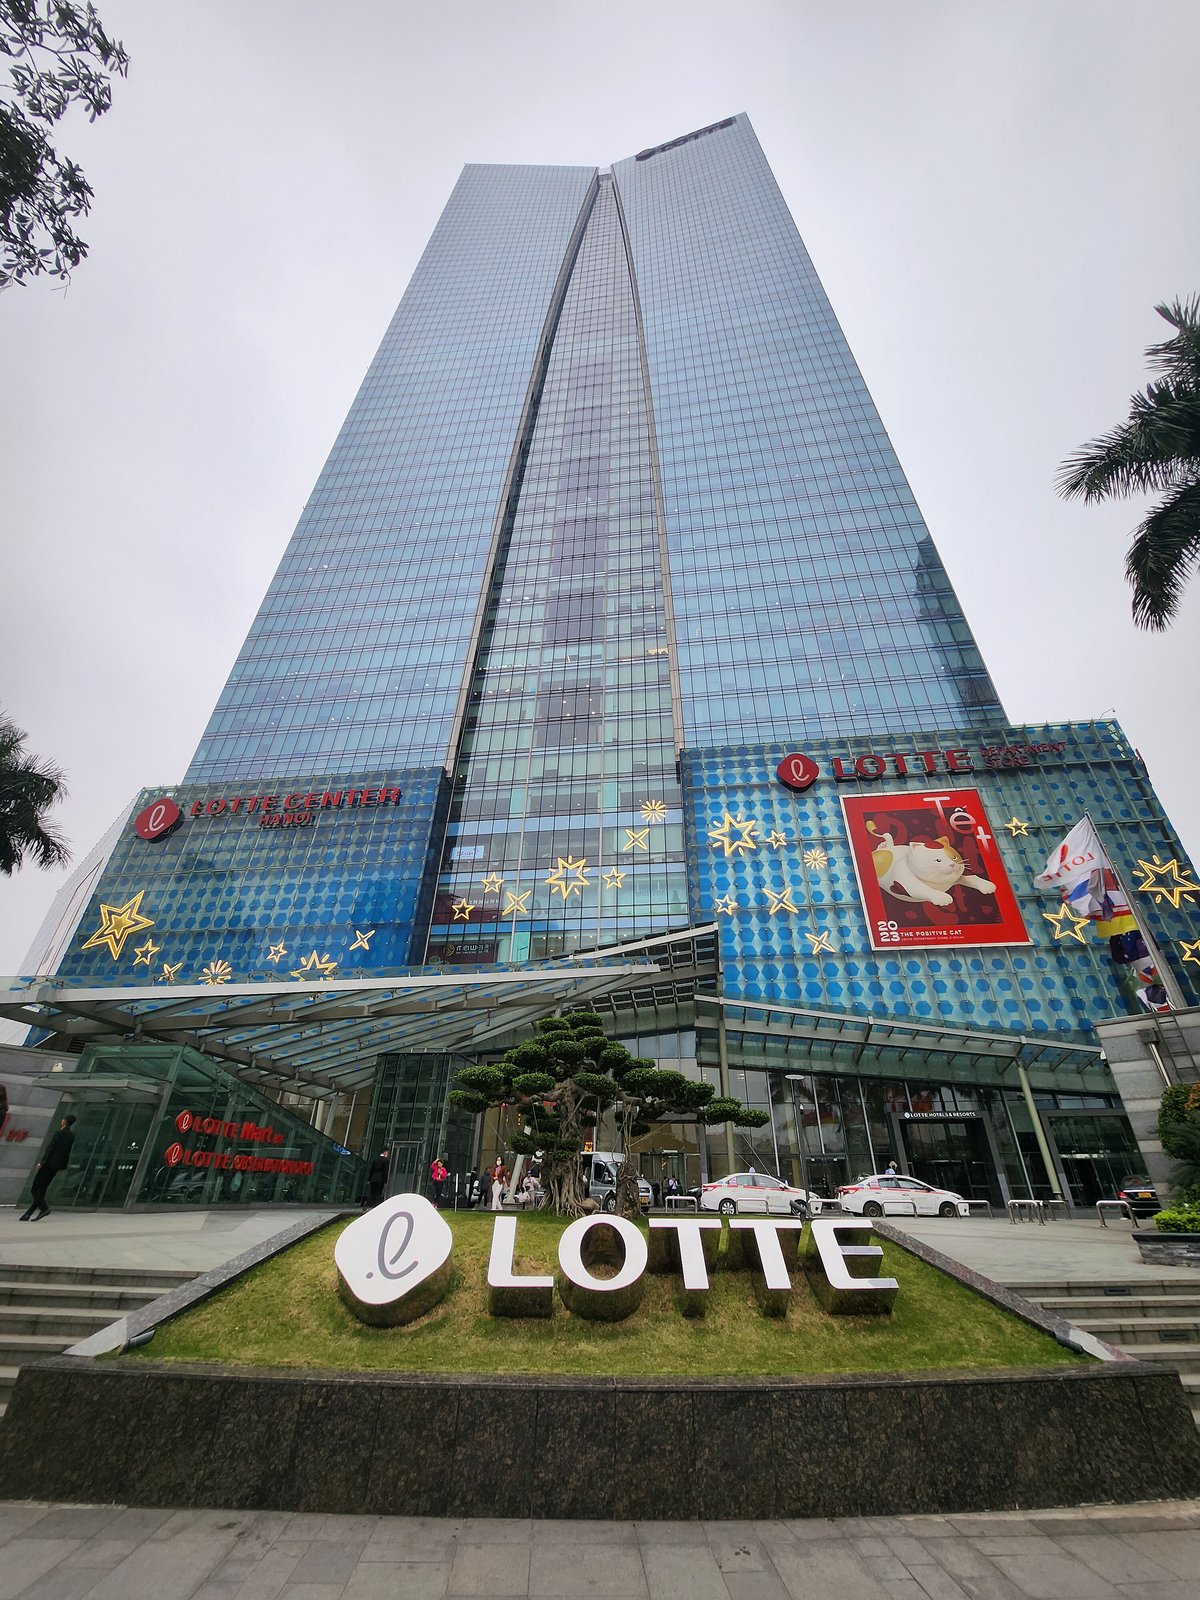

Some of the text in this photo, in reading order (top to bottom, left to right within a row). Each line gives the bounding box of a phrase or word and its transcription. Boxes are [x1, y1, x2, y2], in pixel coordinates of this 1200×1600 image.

[832, 749, 975, 779] LOTTE
[190, 787, 401, 817] LOTTE CENTER
[258, 812, 312, 828] HANOI
[193, 1116, 240, 1138] LOTTE
[240, 1121, 274, 1143] Mart
[182, 1149, 232, 1169] LOTTE
[487, 1214, 900, 1291] LOTTE
